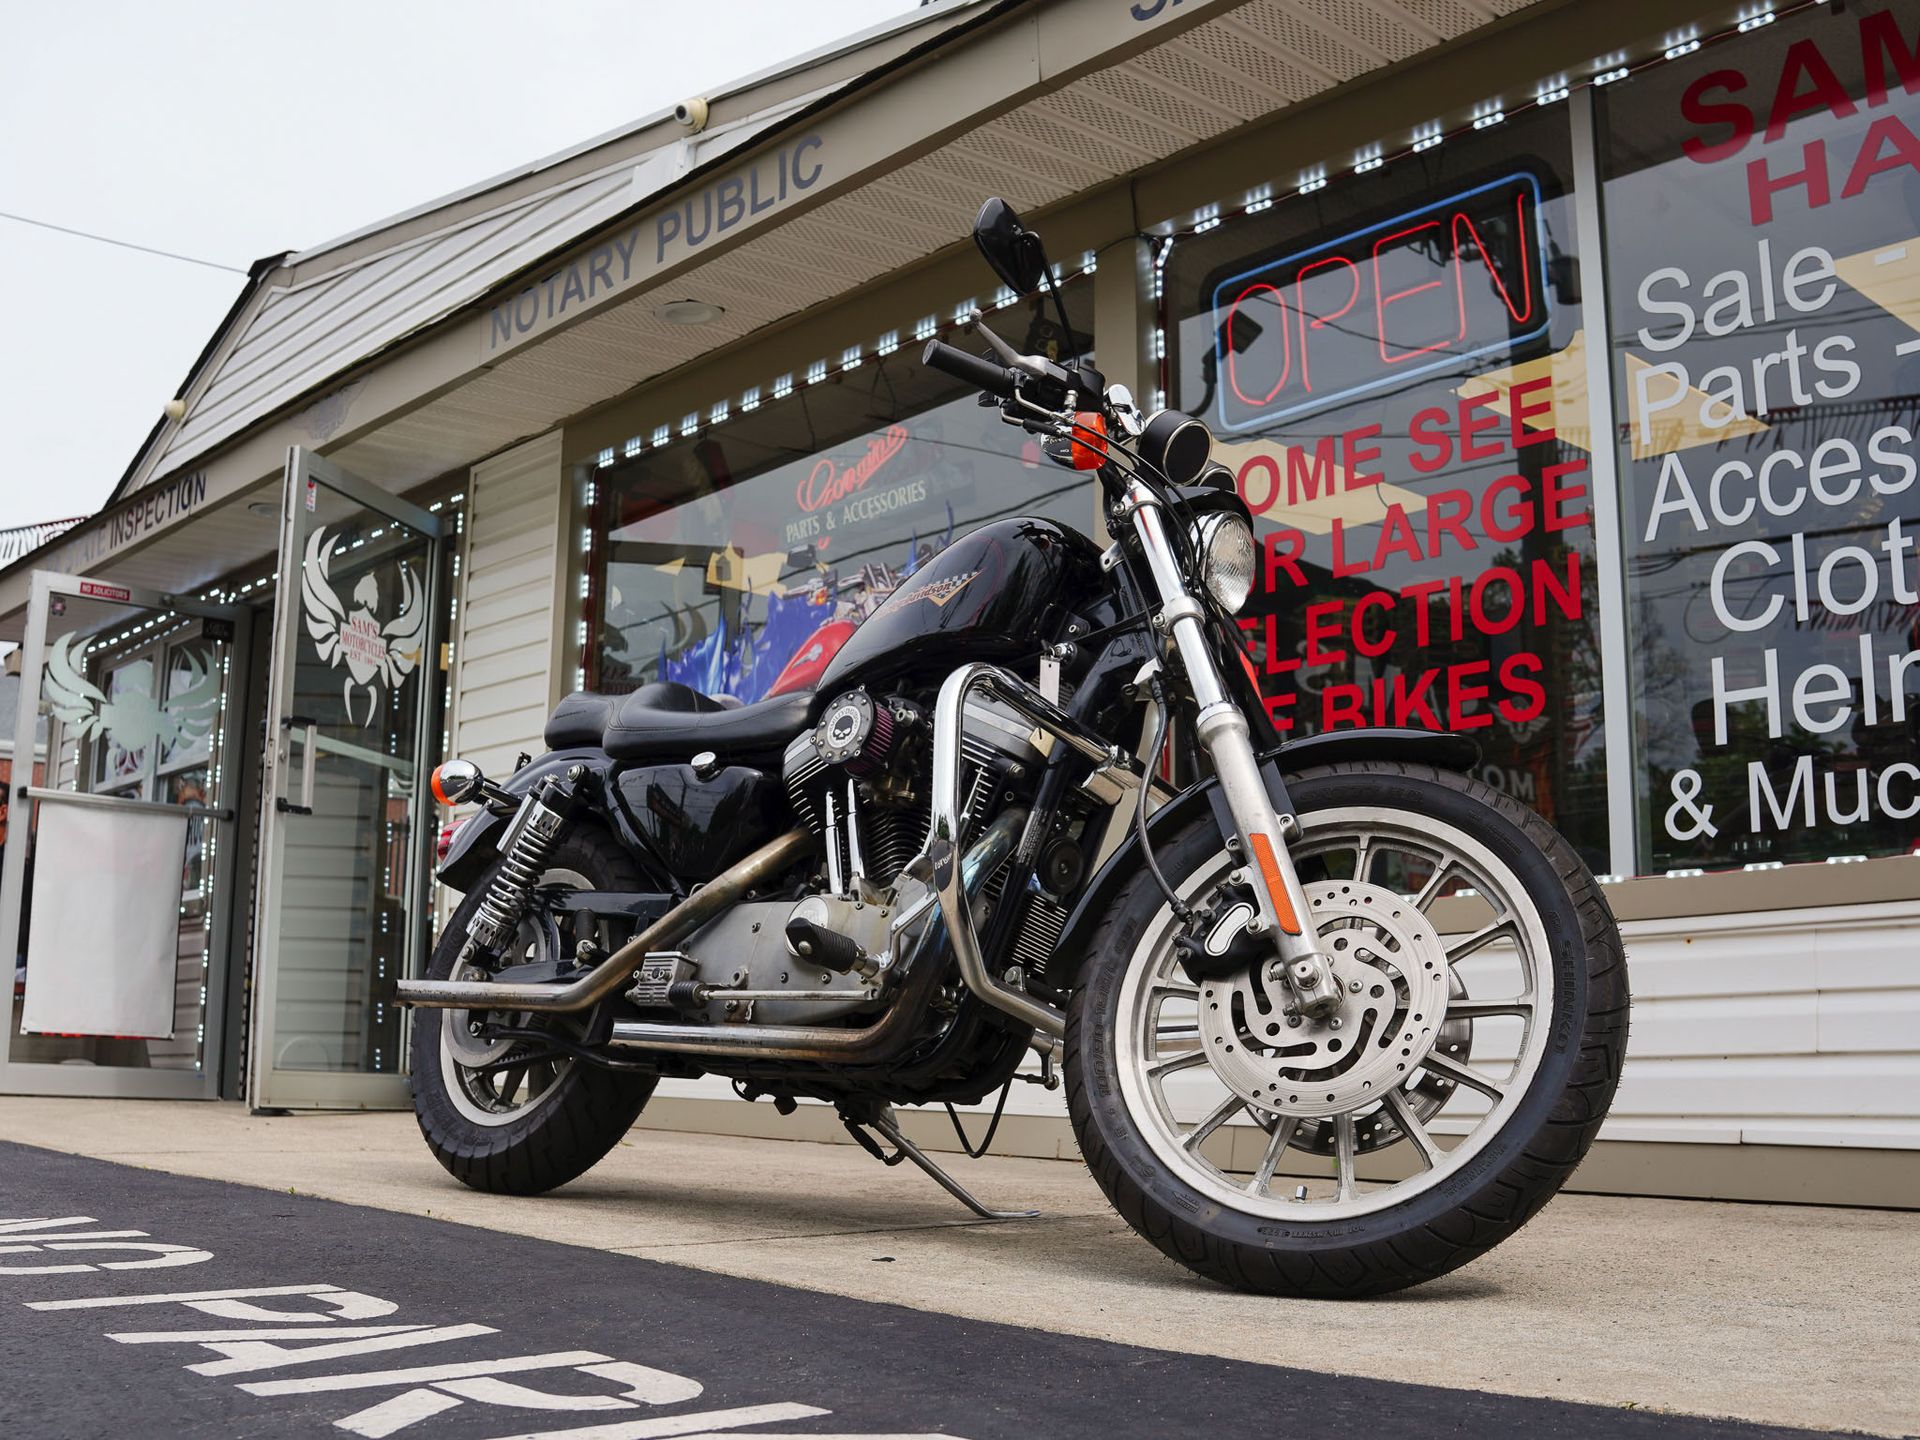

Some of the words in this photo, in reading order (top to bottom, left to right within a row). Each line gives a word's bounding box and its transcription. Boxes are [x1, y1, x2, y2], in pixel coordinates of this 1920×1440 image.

[1746, 115, 1920, 226] HA
[489, 228, 639, 349] NOTARY
[656, 134, 823, 264] PUBLIC
[1227, 194, 1531, 405] OPEN
[1637, 238, 1837, 354] Sale
[1635, 327, 1863, 445] Parts
[1237, 423, 1384, 516] OME
[1408, 376, 1556, 473] SEE
[1644, 424, 1918, 542] Acces
[110, 472, 207, 549] INSPECTION
[786, 515, 821, 543] PARTS
[826, 511, 836, 530] &
[843, 480, 927, 524] ACCESSORIES
[1331, 459, 1592, 579] LARGE
[82, 584, 92, 593] NO
[93, 586, 128, 599] SOLICITORS
[351, 616, 379, 639] SAM'S
[1710, 516, 1919, 632] Clot
[342, 630, 386, 660] MOTORCYCLES
[1664, 769, 1718, 841] &
[1747, 755, 1920, 833] Muc
[1553, 939, 1577, 1056] SHINKO
